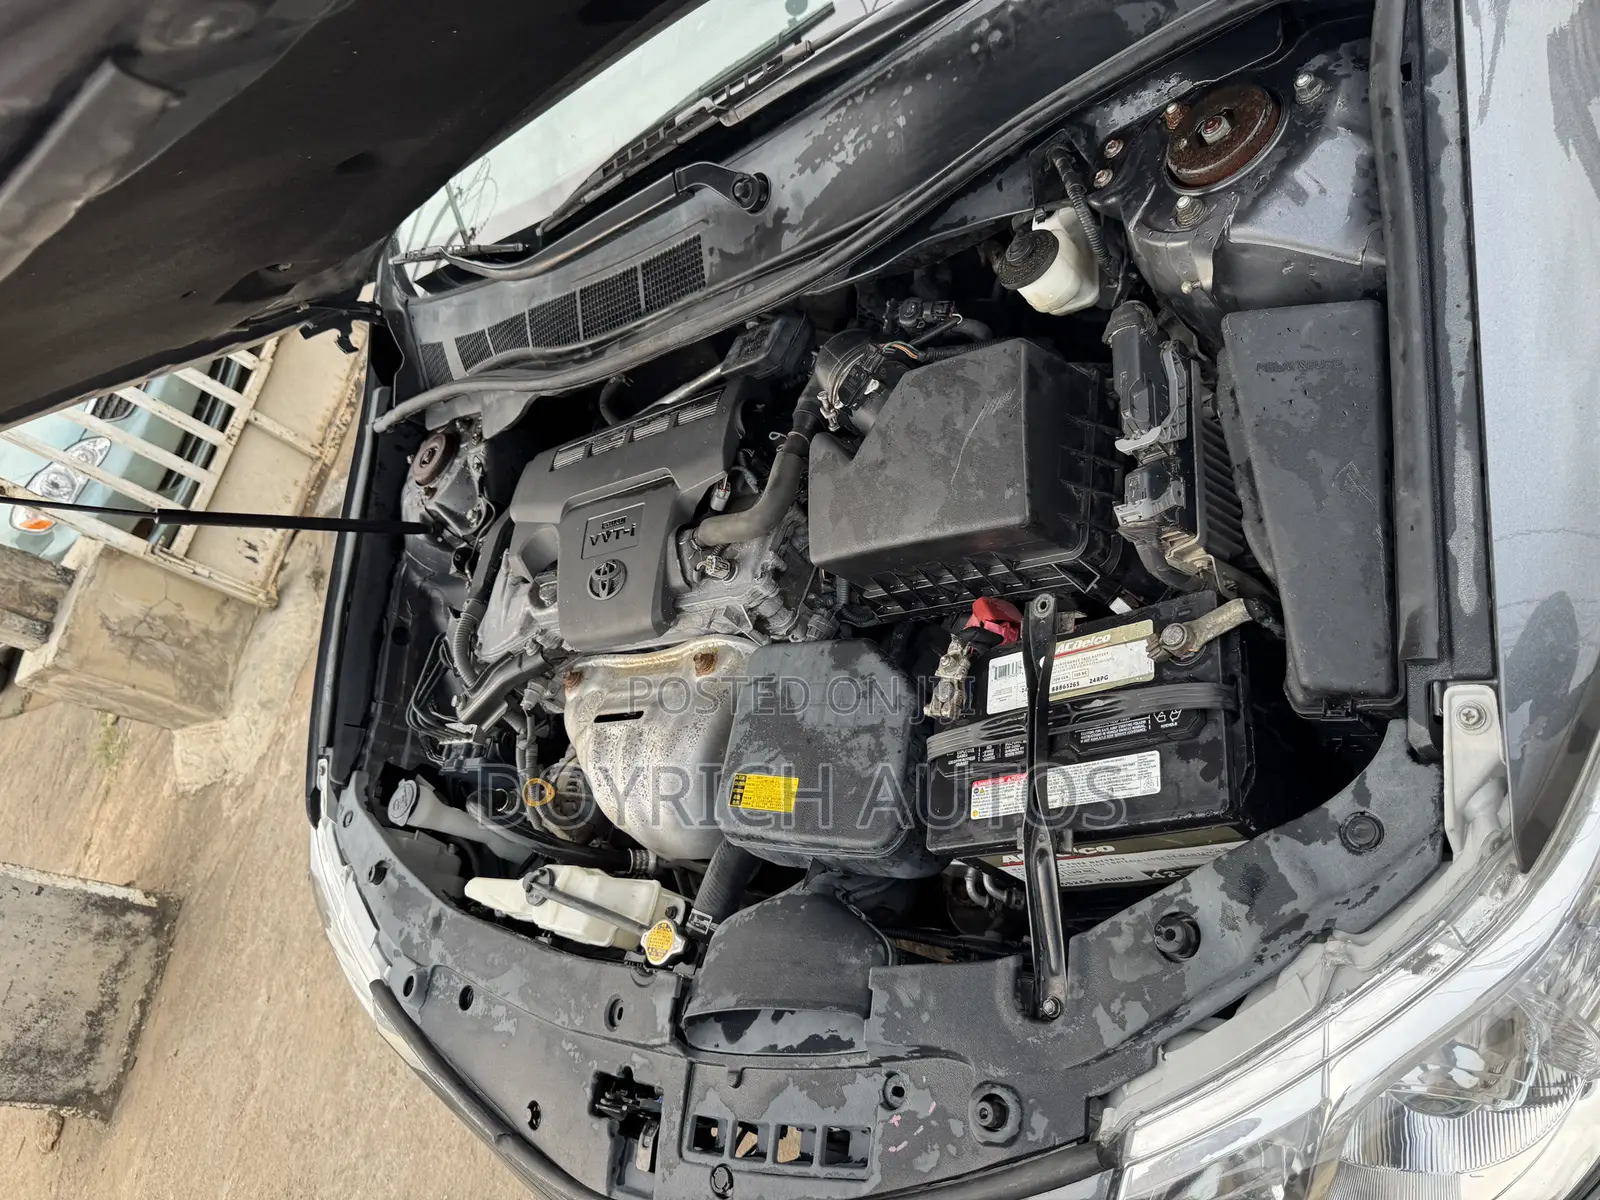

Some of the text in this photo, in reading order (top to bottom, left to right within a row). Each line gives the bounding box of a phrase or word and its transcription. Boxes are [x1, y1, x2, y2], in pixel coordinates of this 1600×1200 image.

[590, 523, 636, 546] VVT-i
[1055, 633, 1111, 653] ACDelco
[1089, 674, 1109, 685] 24RPG
